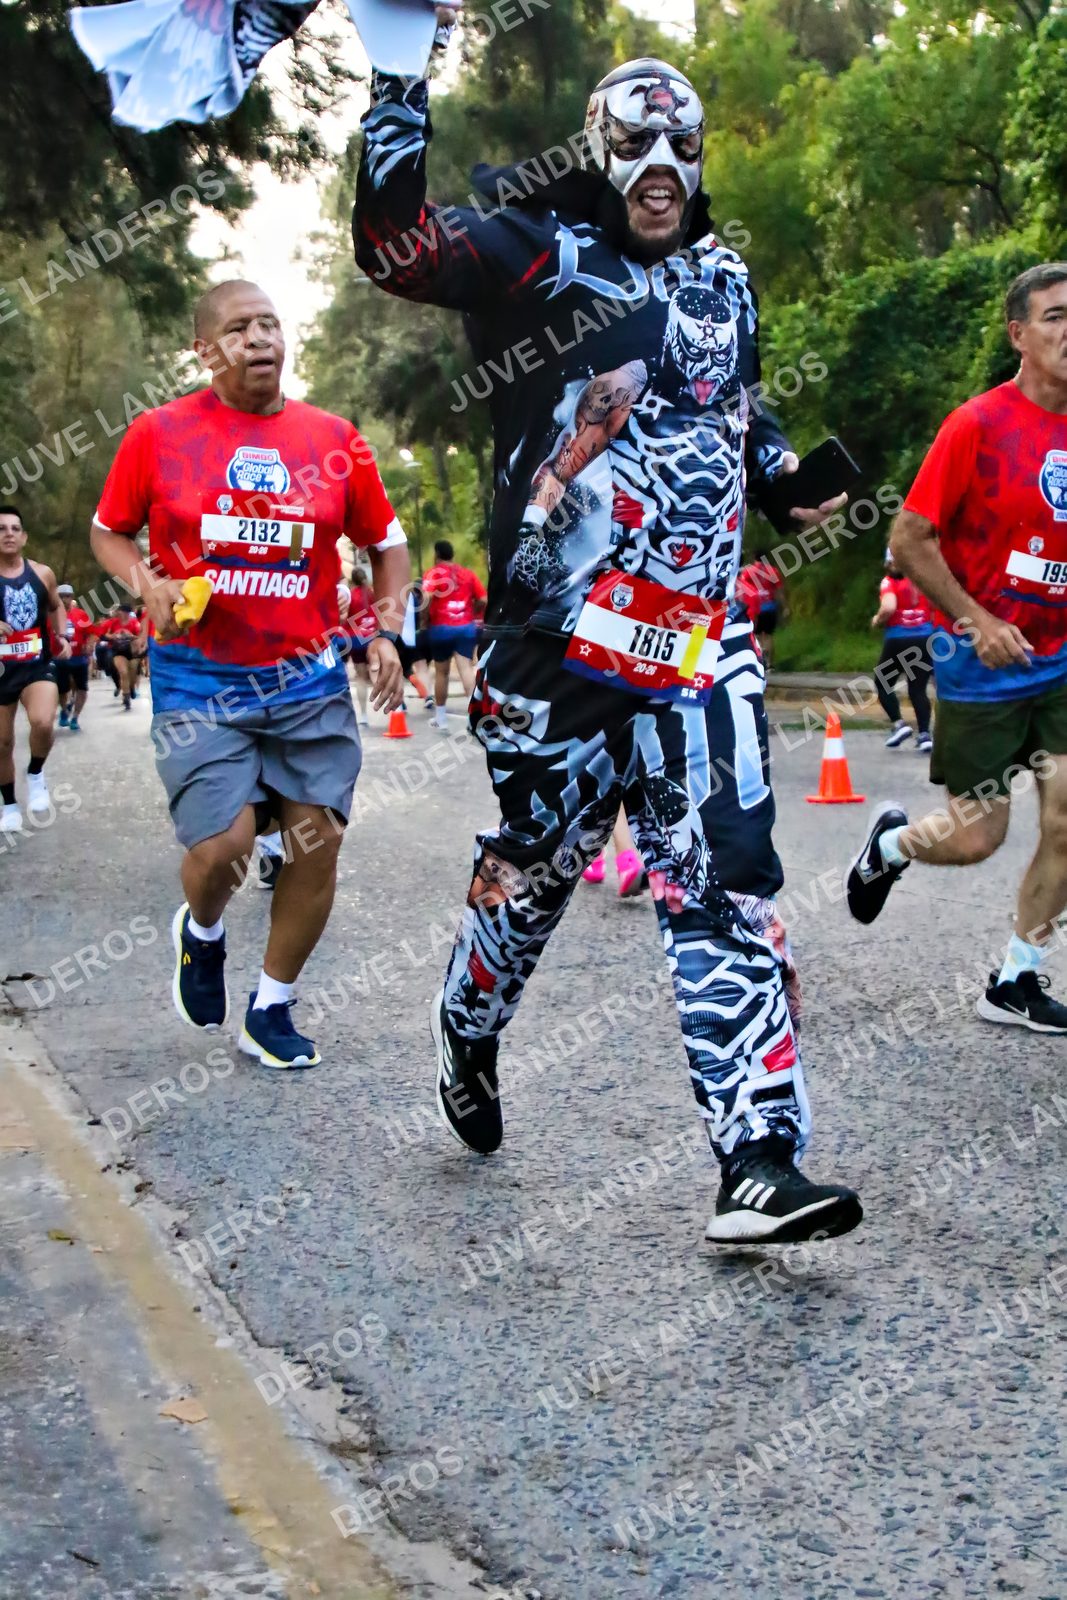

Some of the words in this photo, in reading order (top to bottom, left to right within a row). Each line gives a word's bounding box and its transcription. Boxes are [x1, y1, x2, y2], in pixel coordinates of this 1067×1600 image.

[242, 452, 274, 462] BIMBO
[243, 462, 274, 475] Global
[236, 470, 262, 482] Race
[237, 519, 281, 543] 2132
[203, 569, 310, 599] SANTIAGO
[10, 643, 30, 654] 1637
[628, 624, 678, 662] 1815
[632, 661, 658, 676] 20-26
[680, 687, 698, 699] 5K
